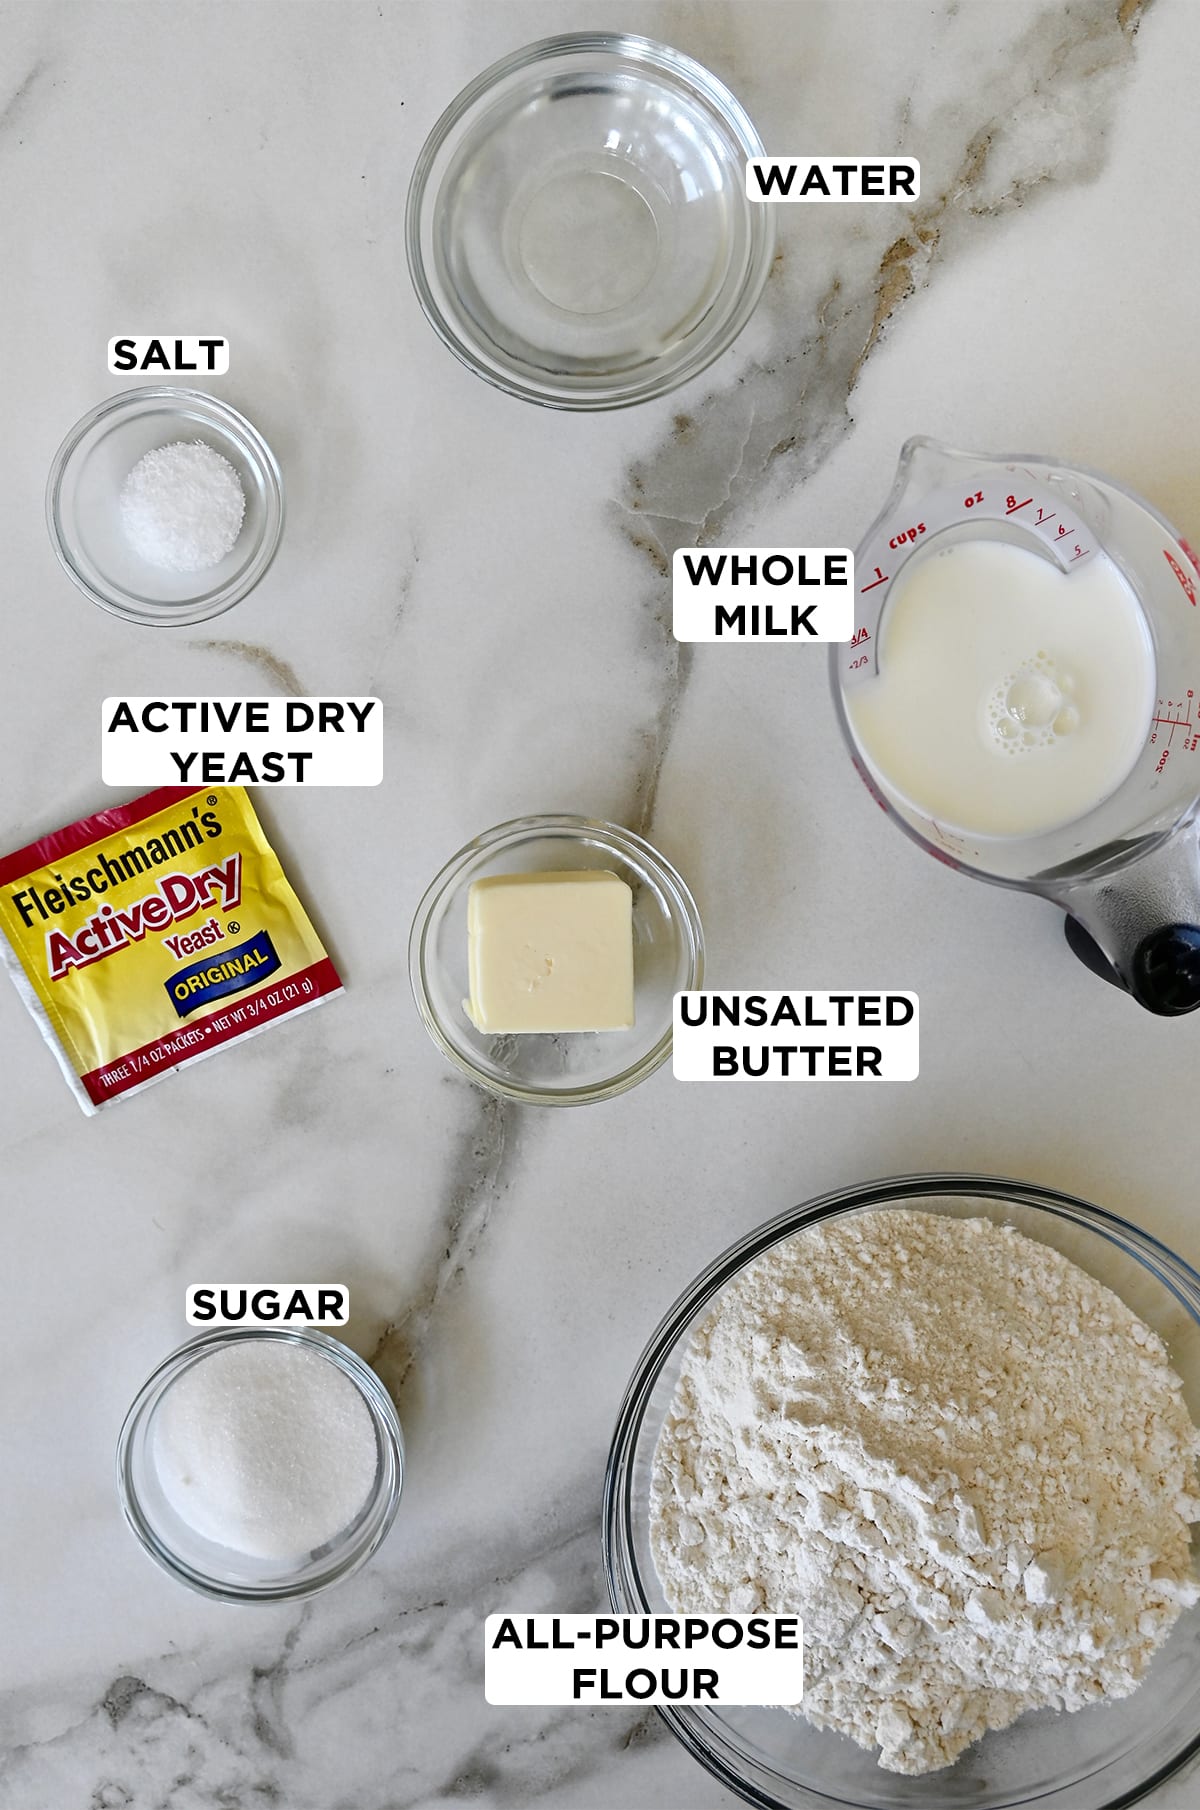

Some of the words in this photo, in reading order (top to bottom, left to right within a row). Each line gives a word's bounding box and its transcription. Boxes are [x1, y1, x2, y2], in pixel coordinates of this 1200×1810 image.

[964, 491, 984, 508] oz
[1006, 495, 1016, 509] 8
[1036, 507, 1043, 521] 7
[888, 522, 926, 549] cups
[1058, 524, 1065, 535] 6
[1074, 544, 1081, 556] 5
[873, 567, 883, 579] 1
[11, 806, 223, 928] Fleischmann's
[164, 918, 225, 961] Yeast
[174, 947, 270, 1001] ORIGINAL
[99, 1063, 131, 1088] THREE
[129, 1056, 150, 1073] 1/4
[149, 1048, 166, 1063] OZ
[164, 1028, 205, 1056] PACKETS
[211, 1014, 232, 1033] NET
[229, 1007, 247, 1024] WT
[246, 998, 267, 1017] 3/4
[266, 990, 283, 1007] OZ
[281, 982, 300, 1001] (21
[301, 977, 314, 994] g)
